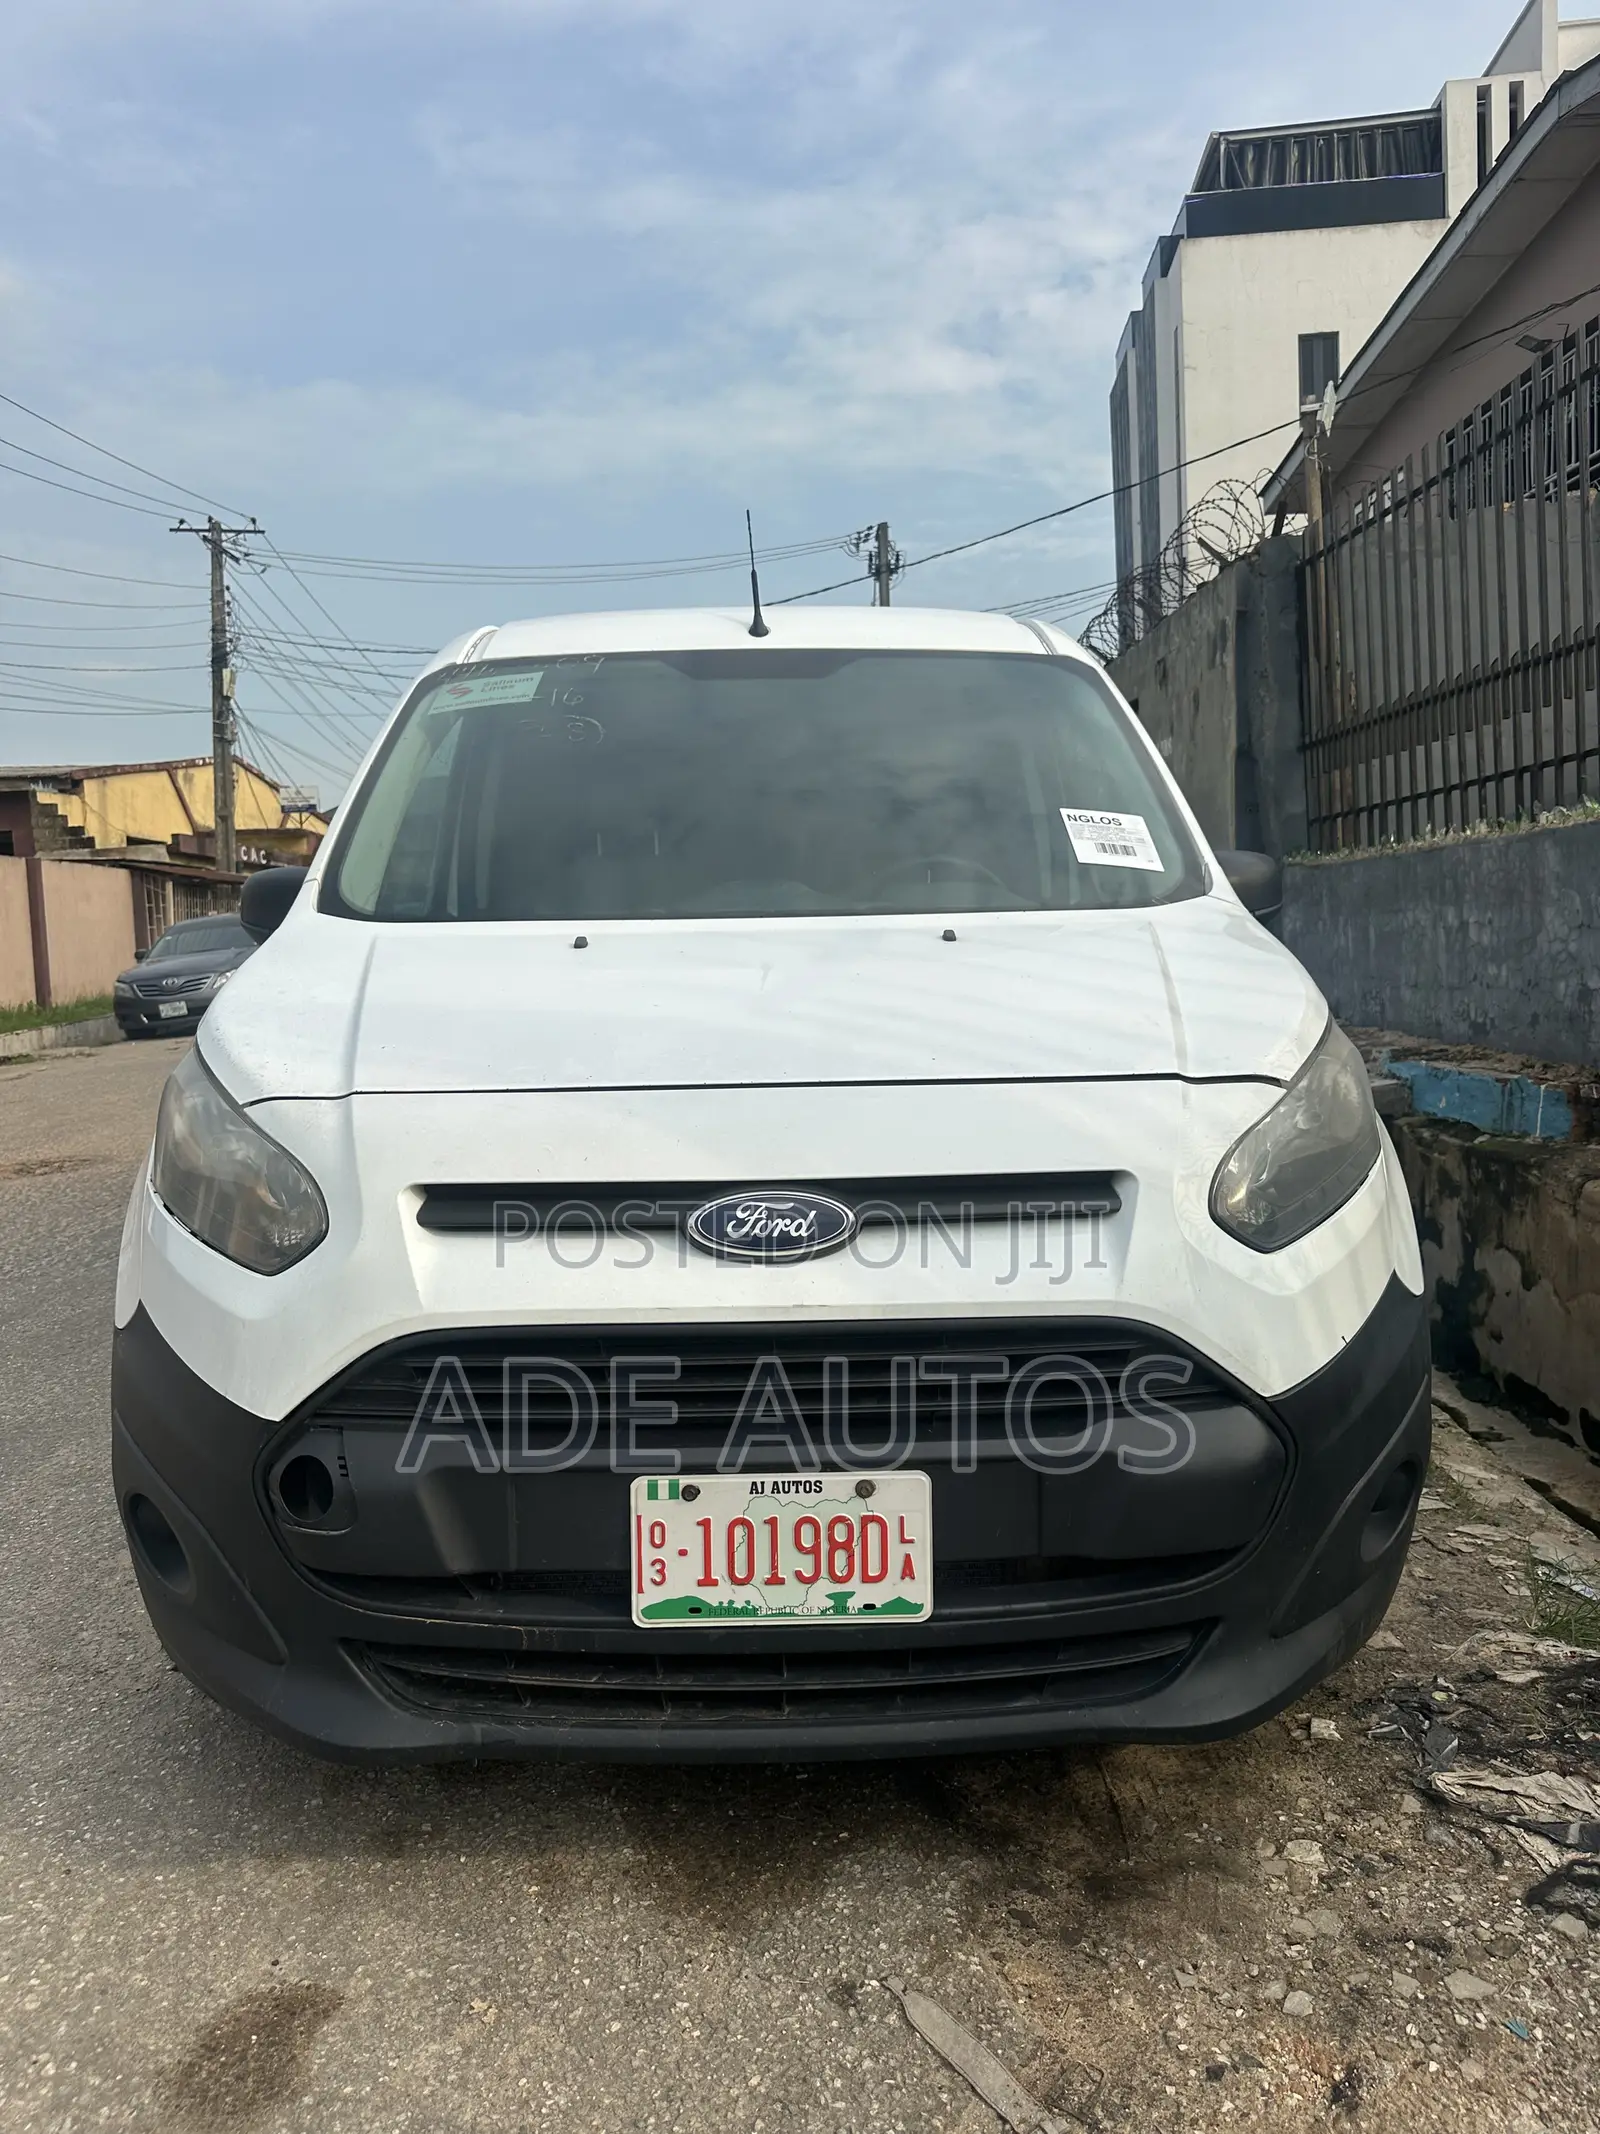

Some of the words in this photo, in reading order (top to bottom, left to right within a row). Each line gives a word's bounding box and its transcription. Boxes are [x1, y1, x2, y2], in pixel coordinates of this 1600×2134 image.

[1066, 813, 1123, 827] NGLOS
[726, 1201, 818, 1239] Ford
[749, 1480, 765, 1495] AJ
[771, 1479, 823, 1495] AUTOS
[708, 1607, 750, 1616] FEDERAL
[801, 1605, 815, 1615] OF
